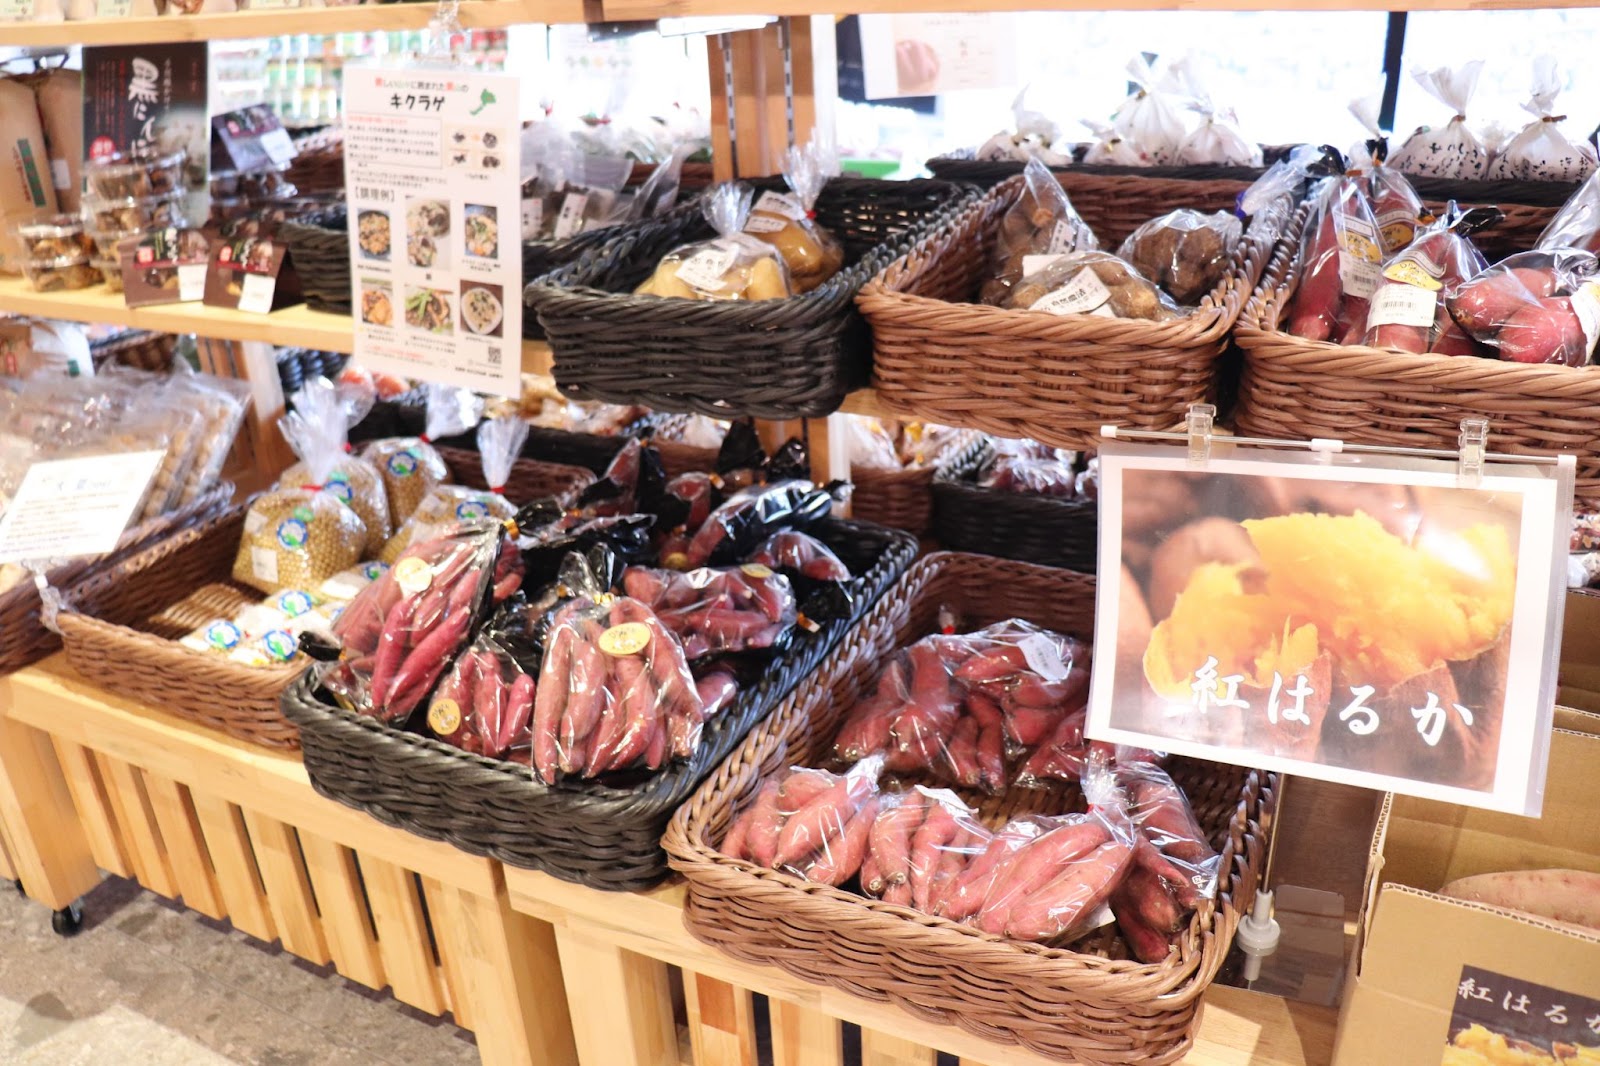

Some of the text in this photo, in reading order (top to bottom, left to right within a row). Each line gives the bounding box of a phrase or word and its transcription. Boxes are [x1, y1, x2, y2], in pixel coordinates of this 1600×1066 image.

[390, 92, 445, 112] キクラゲ
[1190, 655, 1475, 747] 紅はるか
